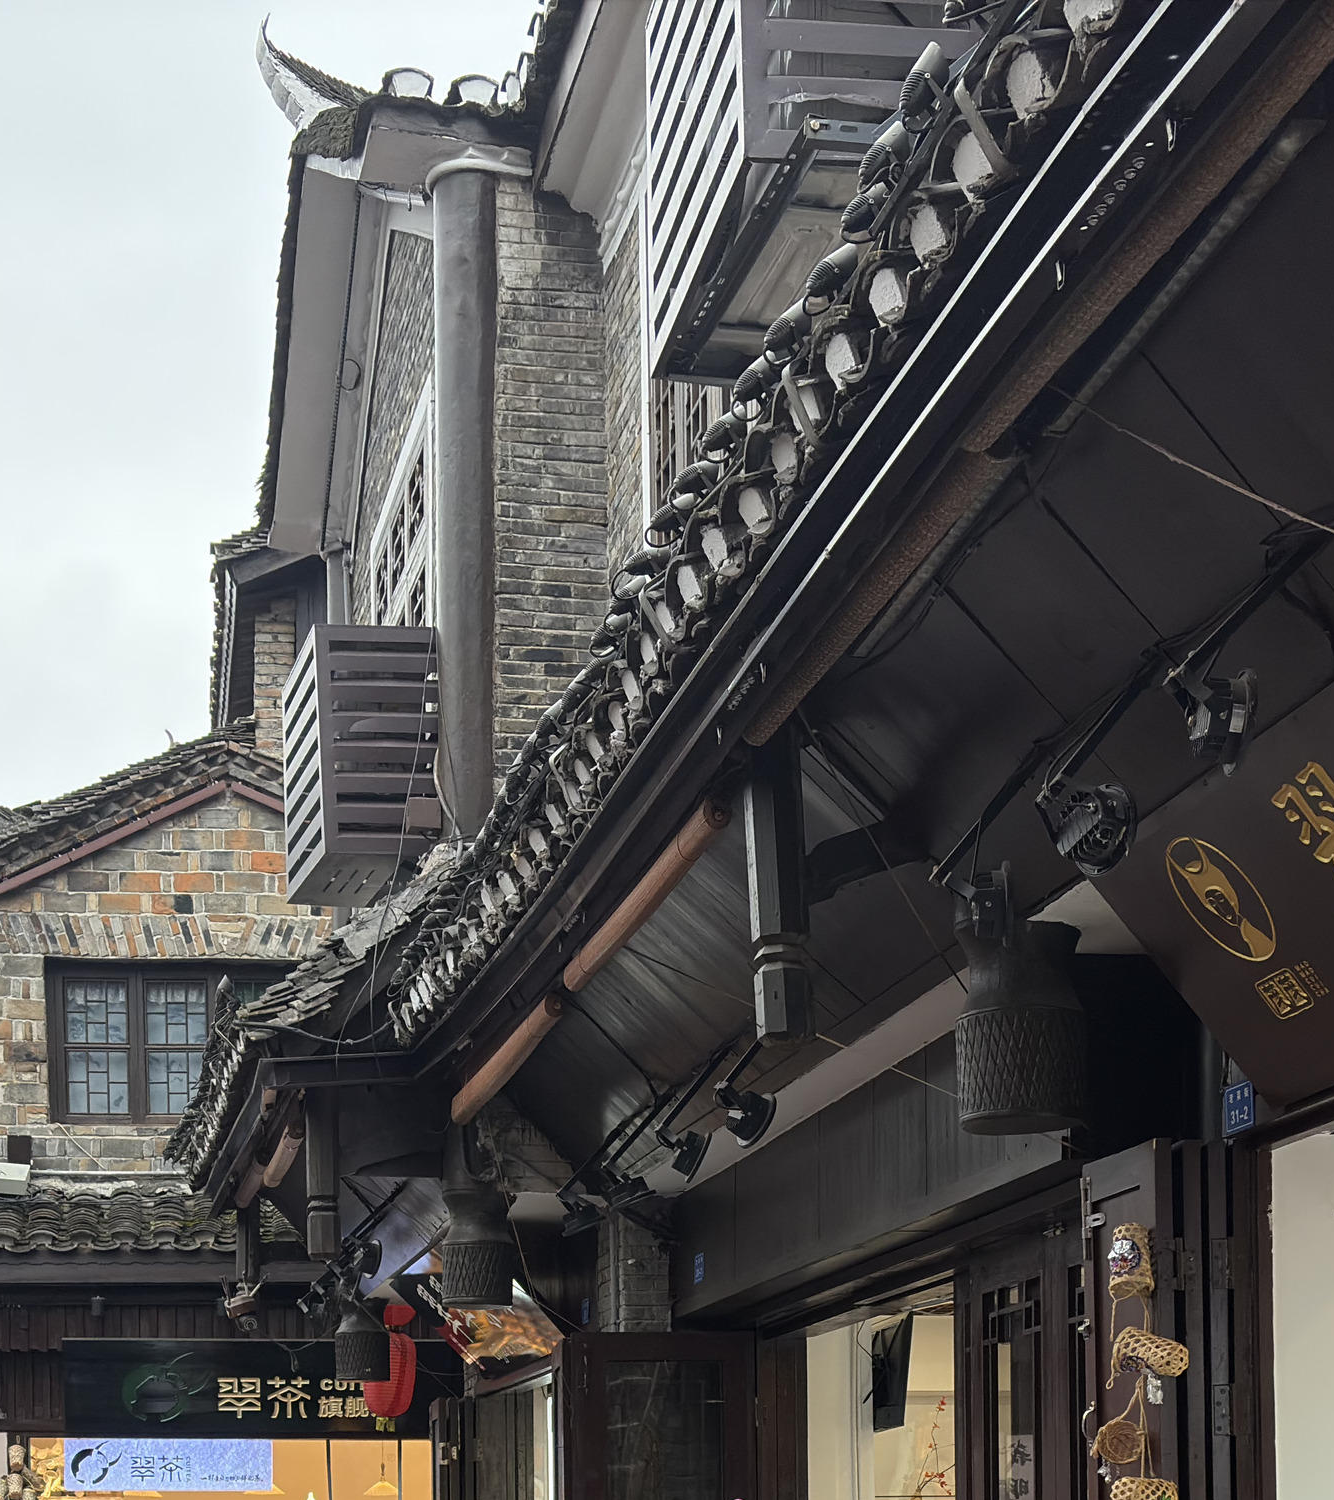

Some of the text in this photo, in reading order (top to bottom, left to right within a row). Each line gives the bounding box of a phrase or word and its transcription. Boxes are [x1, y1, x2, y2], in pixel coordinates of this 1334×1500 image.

[1230, 1106, 1249, 1125] 31-2
[217, 1375, 311, 1419] 翠茶
[318, 1395, 377, 1418] 旗舰
[130, 1455, 184, 1483] 翠茶
